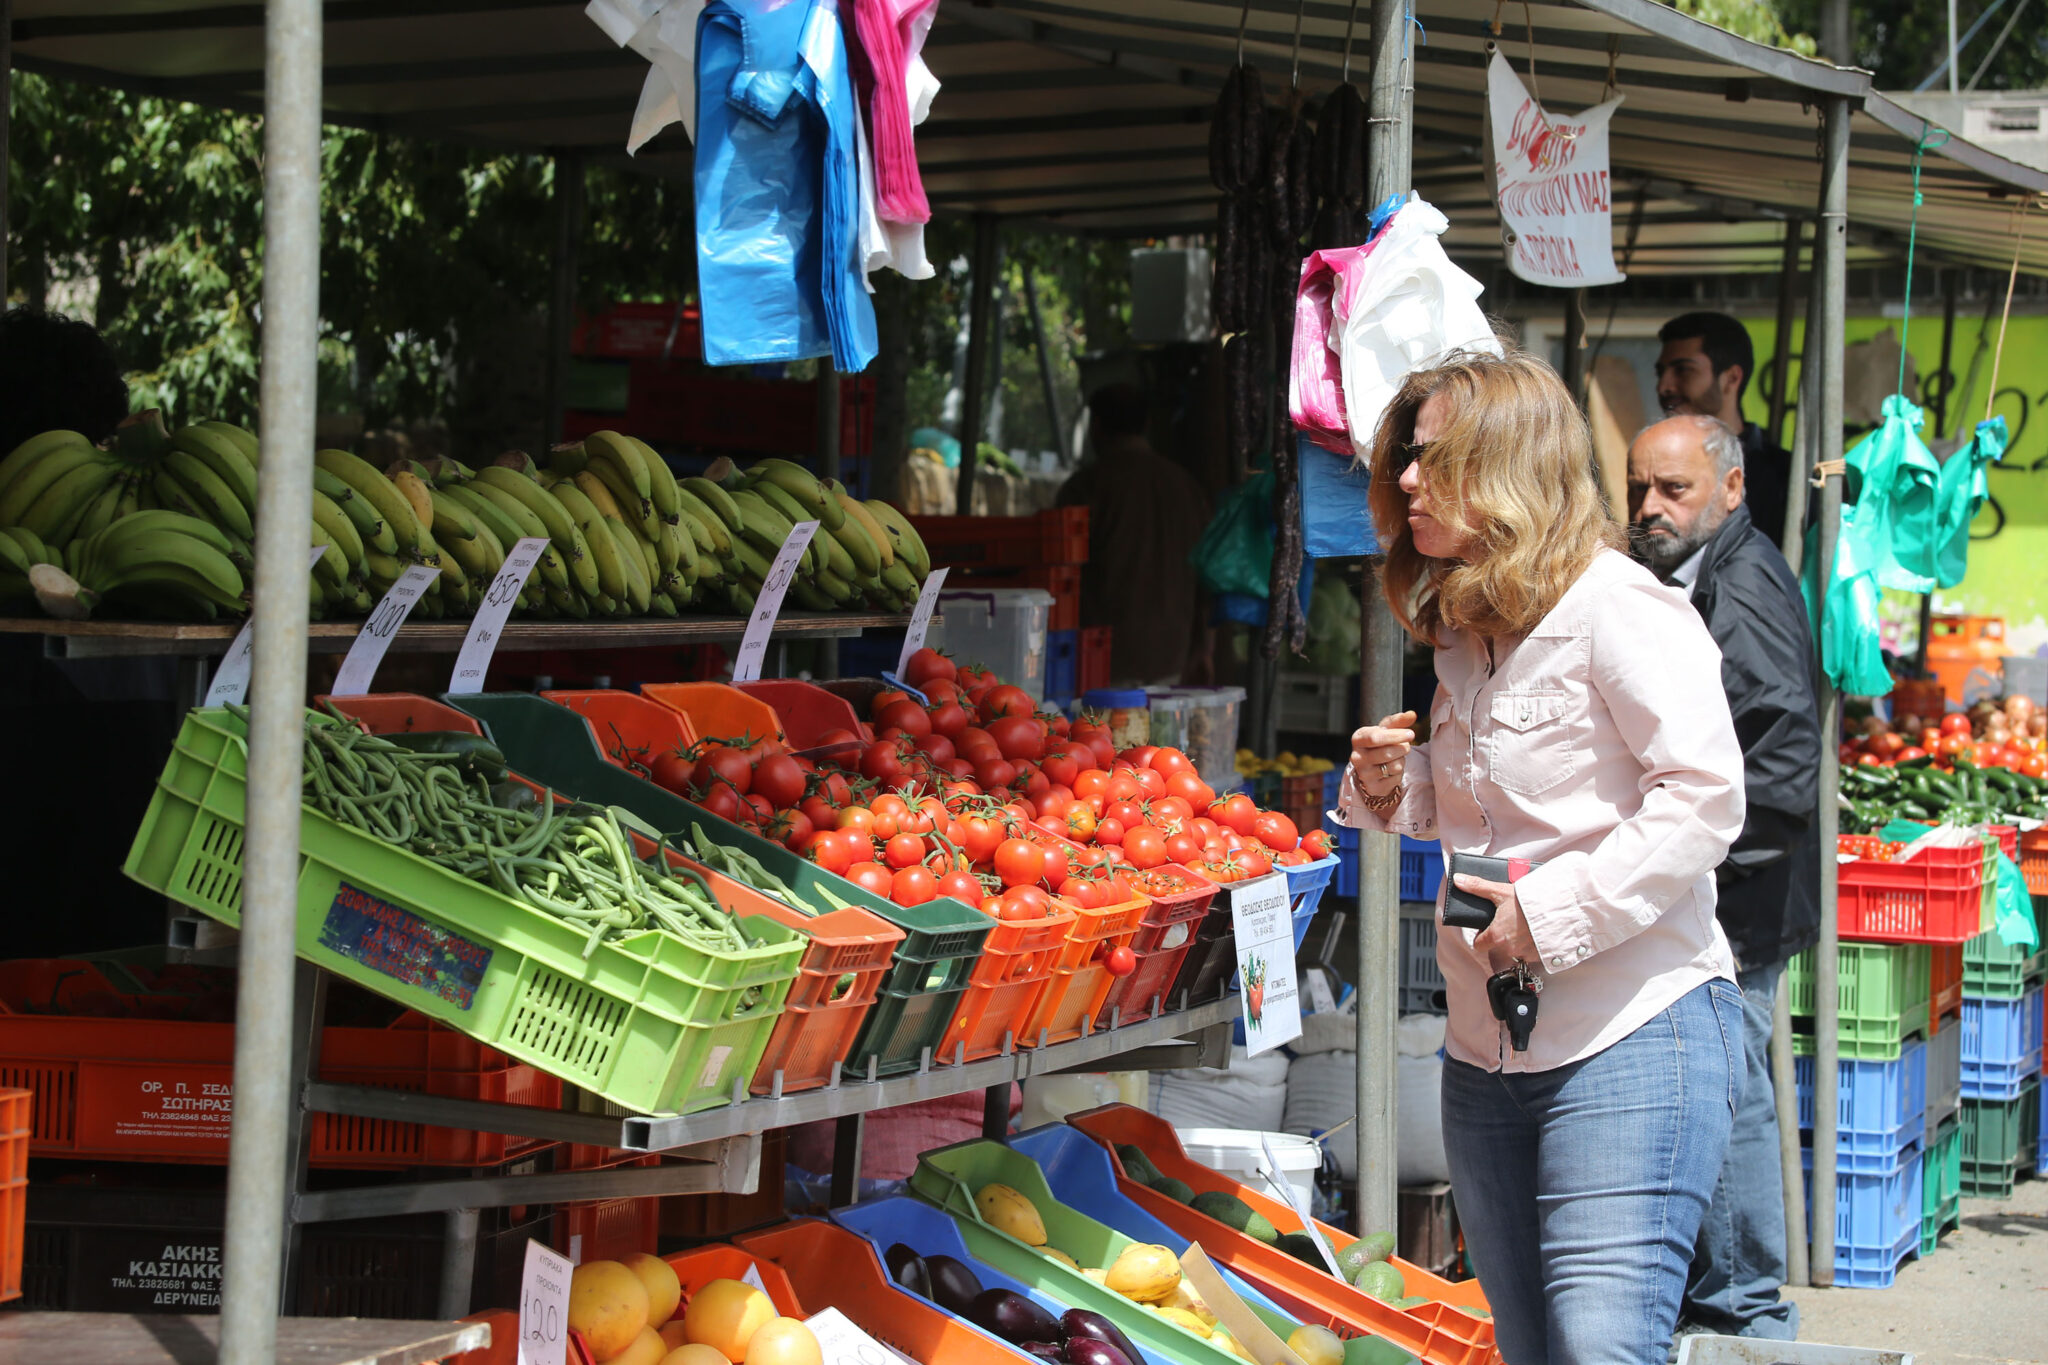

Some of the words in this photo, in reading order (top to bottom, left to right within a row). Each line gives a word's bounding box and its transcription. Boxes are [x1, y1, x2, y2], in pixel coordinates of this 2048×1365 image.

[366, 597, 407, 638] 200
[141, 1081, 164, 1094] ΟΡ.
[175, 1083, 191, 1095] Π.
[162, 1097, 233, 1112] ΣΩΤΗΡΑΣ
[161, 1245, 220, 1262] ΑΚΗΣ
[112, 1278, 136, 1288] ΤΗΛ.
[153, 1292, 223, 1307] ΔΕΡΥΝΕΙΑ
[522, 1288, 558, 1344] 120
